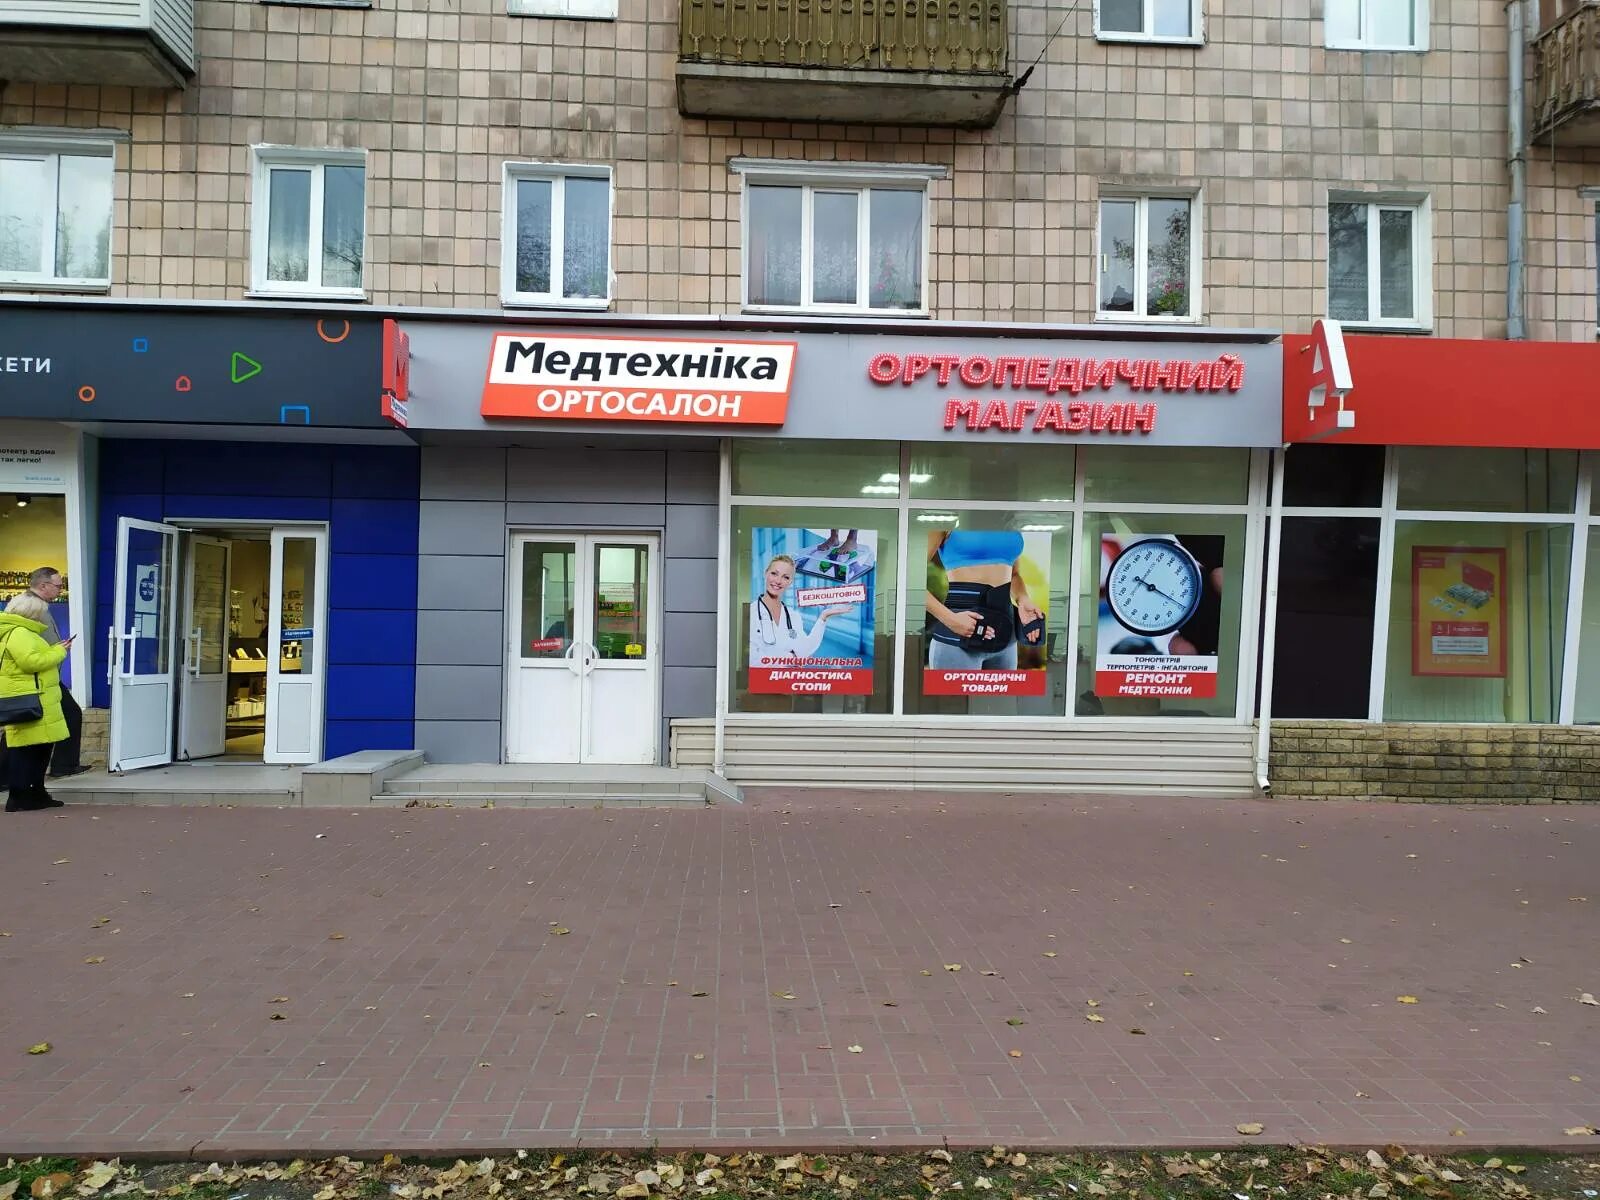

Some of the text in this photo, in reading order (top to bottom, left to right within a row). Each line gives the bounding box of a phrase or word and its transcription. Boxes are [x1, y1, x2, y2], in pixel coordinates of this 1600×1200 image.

[0, 357, 51, 373] ЕТИ
[505, 341, 778, 381] Медтехніка
[868, 352, 1246, 393] ОРТОПЕДИЧНИЙ
[537, 389, 742, 417] ОРТОСАЛОН
[943, 398, 1158, 433] МАГАЗИН
[802, 590, 861, 601] БЕЗКОШТОВНО
[1166, 610, 1173, 618] 20
[760, 657, 862, 667] ФУНКЦІОНАЛЬНА
[769, 670, 852, 681] ДІАГНОСТИКА
[943, 672, 1026, 682] ОРТОПЕДИЧНІ
[1125, 673, 1187, 684] РЕМОНТ
[791, 682, 832, 691] СТОПИ
[961, 684, 1008, 693] ТОВАРИ
[1118, 685, 1192, 695] МЕДТЕХНІКИ
